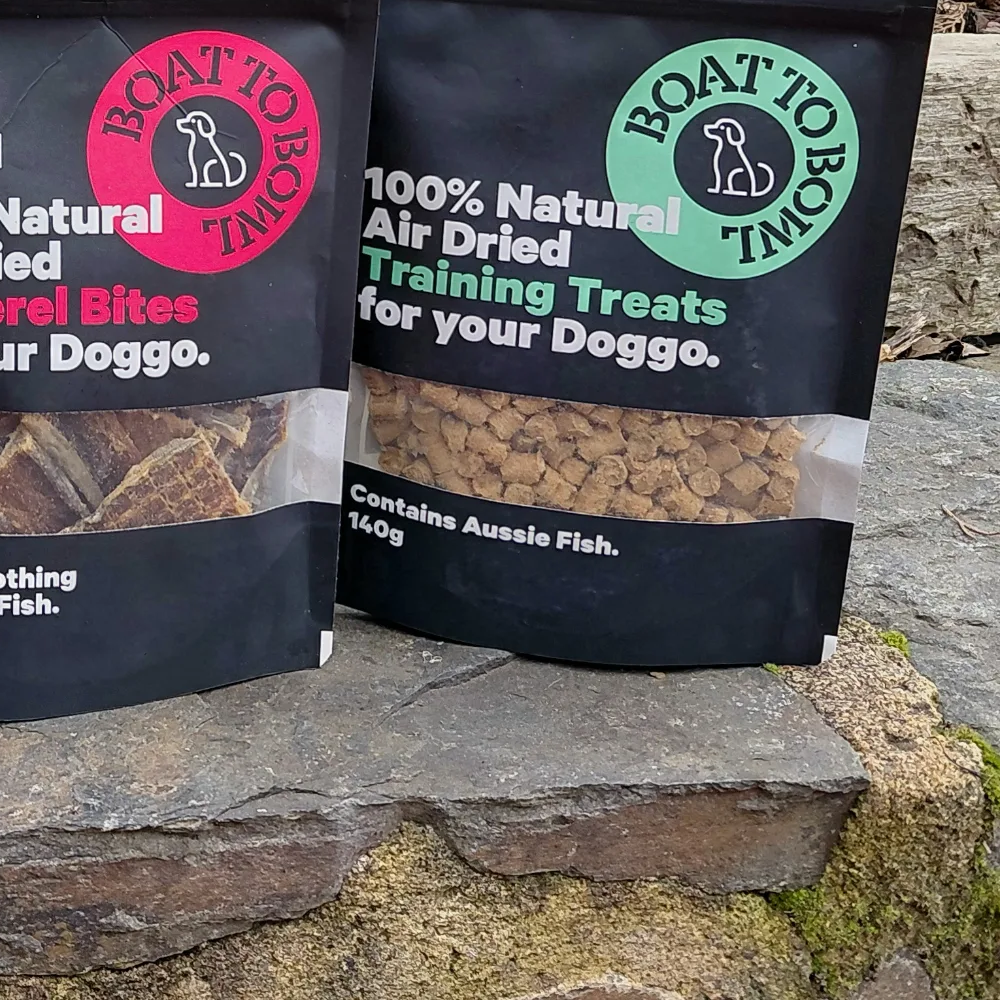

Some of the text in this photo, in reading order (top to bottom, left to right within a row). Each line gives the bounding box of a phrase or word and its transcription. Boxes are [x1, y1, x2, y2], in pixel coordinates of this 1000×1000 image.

[102, 46, 309, 256] BOAT TO BOWL
[623, 53, 846, 264] BOAT TO BOWL
[364, 167, 681, 236] 100% Natural
[362, 207, 572, 268] Air Dried
[81, 285, 199, 326] Bites
[362, 246, 727, 326] Training Treats
[50, 334, 210, 380] Doggo.
[358, 286, 720, 372] for your Doggo.
[348, 511, 405, 547] 140g
[349, 483, 619, 557] Contains Aussie Fish.
